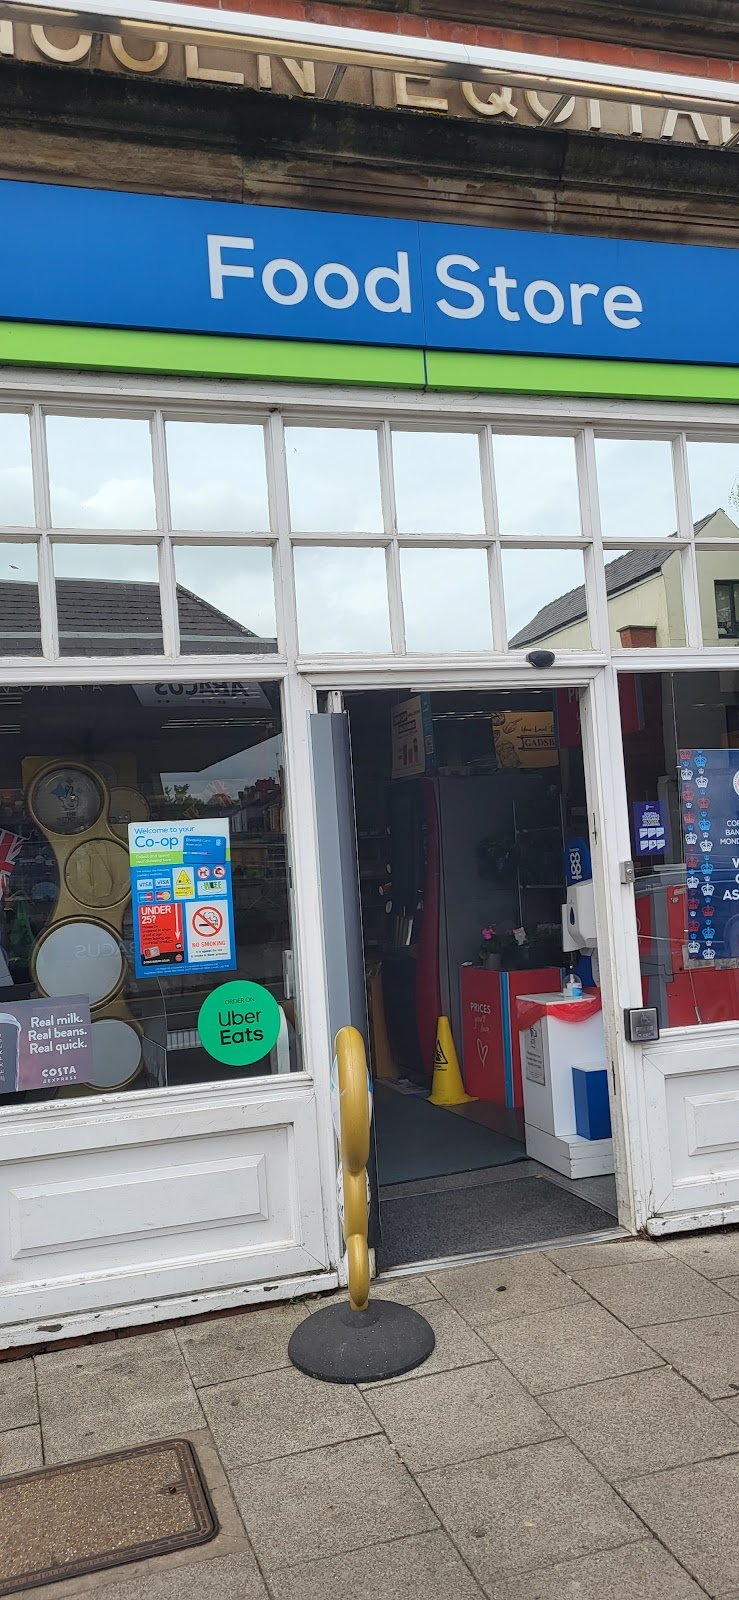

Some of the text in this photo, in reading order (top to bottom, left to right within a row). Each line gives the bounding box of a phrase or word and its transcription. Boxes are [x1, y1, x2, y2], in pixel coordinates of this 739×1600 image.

[206, 233, 643, 329] Food Store
[134, 827, 168, 835] Welcome
[135, 835, 179, 849] Co-op
[141, 905, 172, 916] UNDER
[141, 914, 157, 925] 25?
[470, 1002, 491, 1014] PRICES
[31, 1012, 84, 1028] Real milk.
[218, 1010, 261, 1027] Uber
[28, 1028, 88, 1042] Real beans.
[220, 1028, 264, 1046] Eats
[29, 1038, 88, 1055] Real quick.
[42, 1065, 77, 1078] COSTA
[48, 1075, 77, 1083] EXPRESS
